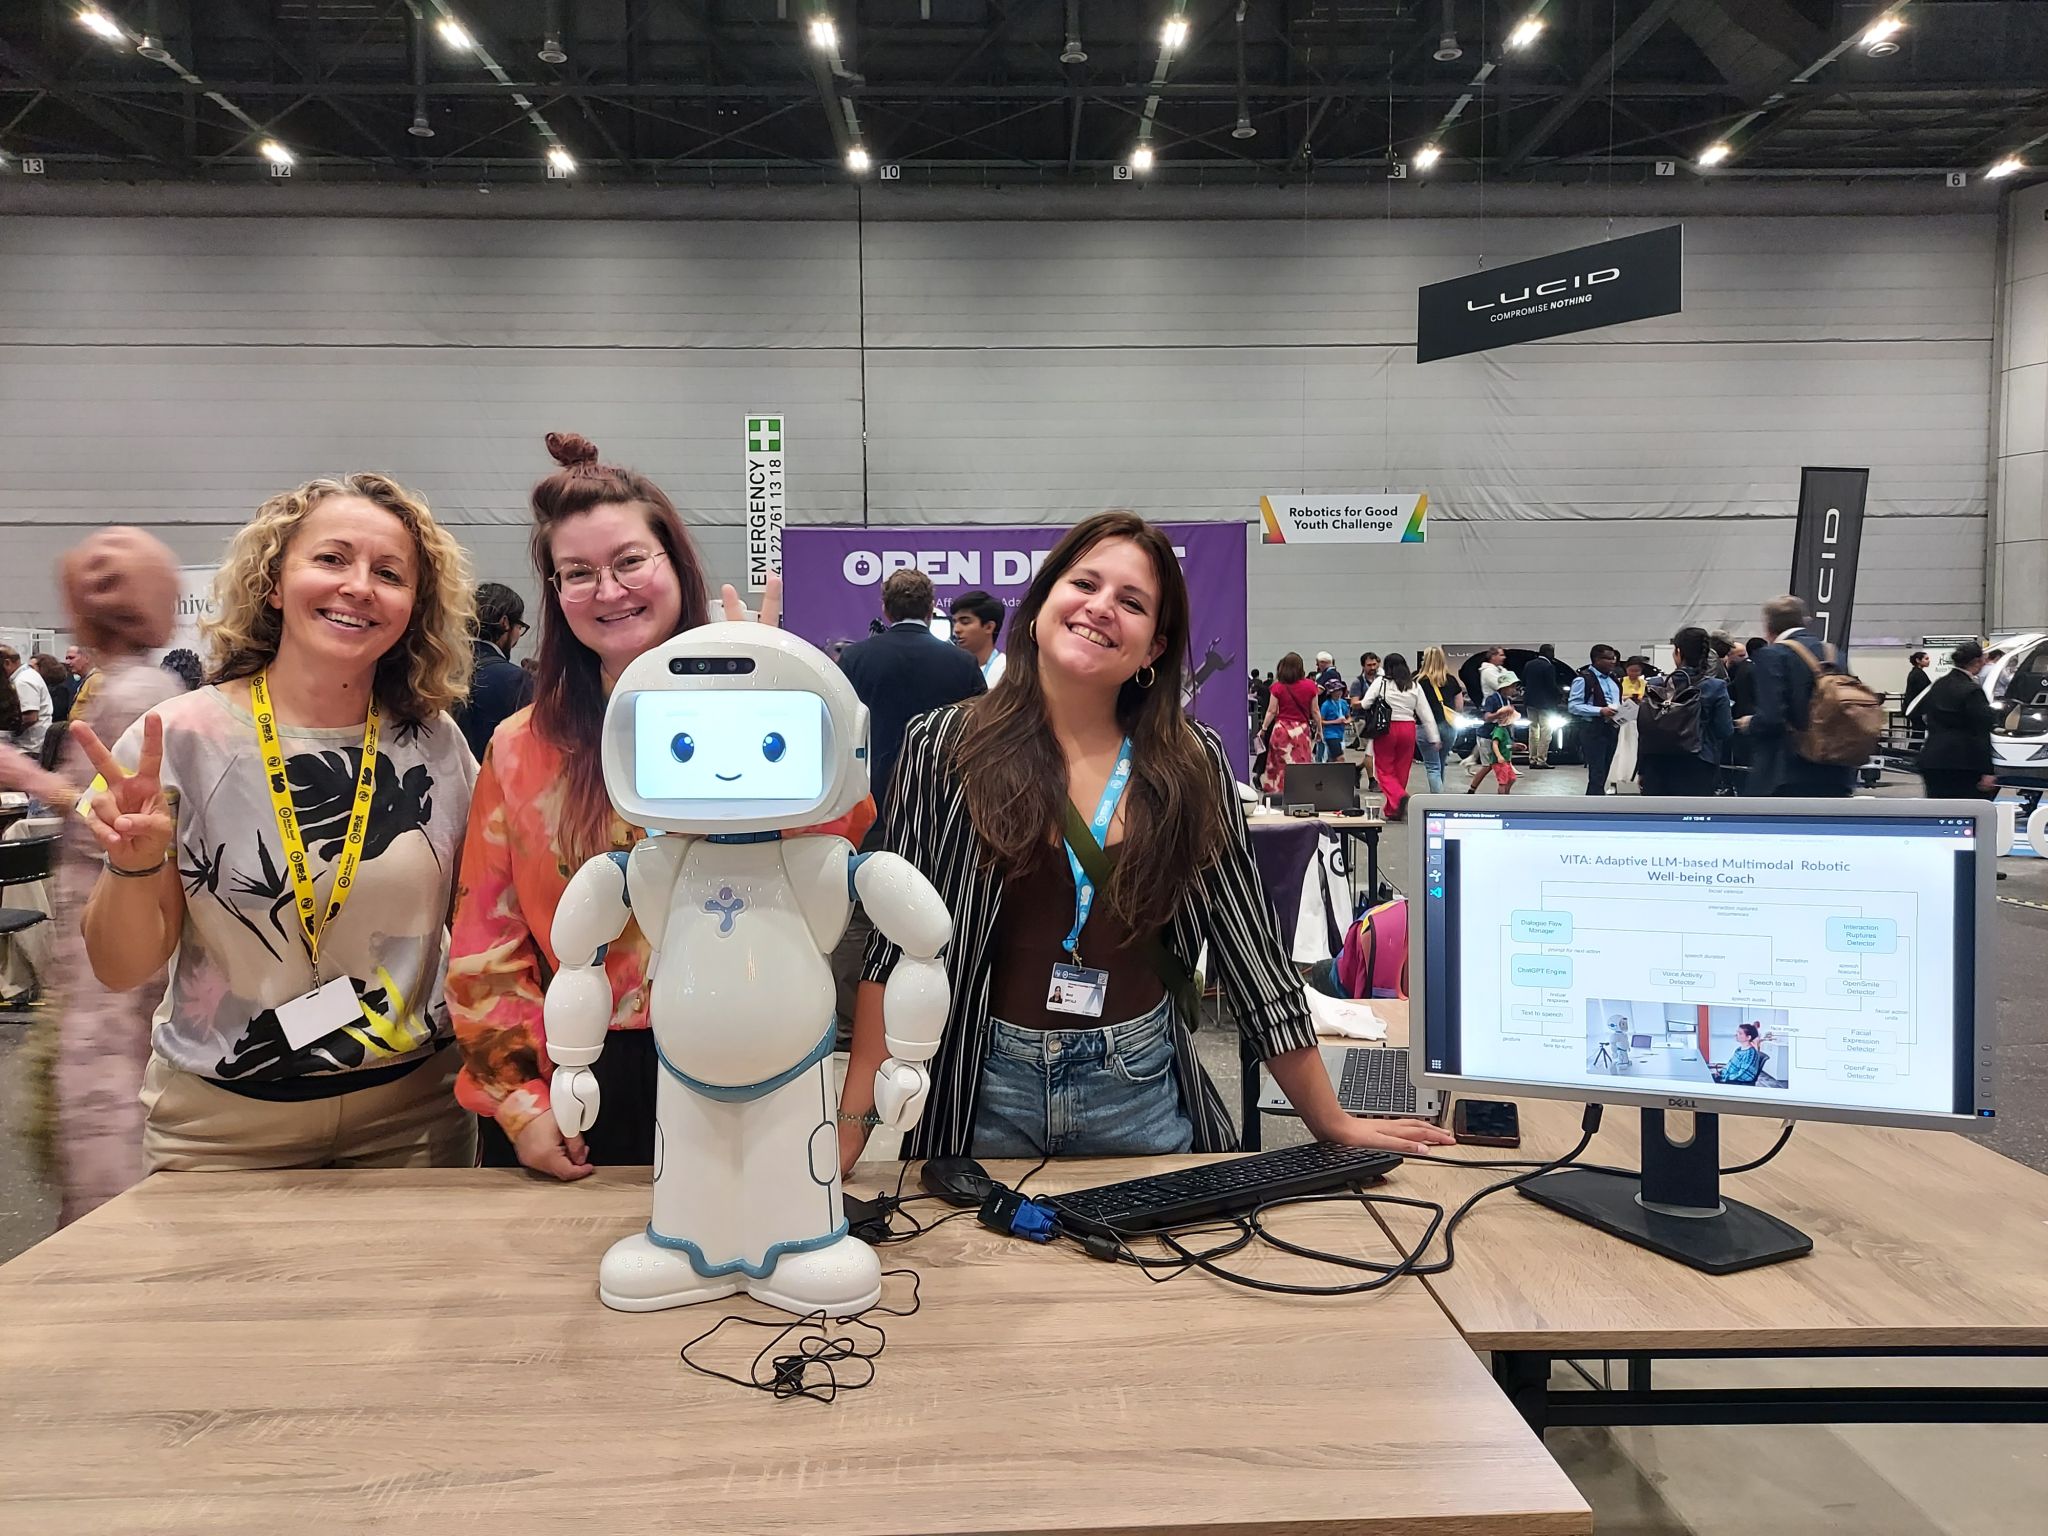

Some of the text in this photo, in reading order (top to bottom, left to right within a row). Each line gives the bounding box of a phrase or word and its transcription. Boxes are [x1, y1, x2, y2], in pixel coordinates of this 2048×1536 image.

[24, 159, 42, 173] 13
[272, 164, 289, 176] 12
[1661, 162, 1669, 175] 7
[881, 165, 899, 178] 10
[1118, 166, 1127, 179] 9
[1951, 173, 1960, 186] 6
[1467, 267, 1620, 312] LUCID
[1490, 294, 1593, 323] COMPROMISE NOTHING
[1289, 506, 1398, 517] Robotics for Good
[750, 459, 767, 586] EMERGENCY
[769, 459, 782, 577] 41 22 761 13 18
[1294, 519, 1393, 532] Youth Challenge
[843, 550, 981, 586] OPEN
[1816, 508, 1840, 643] UCID
[172, 593, 215, 615] hive
[1560, 854, 1851, 872] VITA: Adaptive LLM-based Multimodal Robotic
[1647, 871, 1755, 884] Well-being Coach
[1521, 920, 1547, 928] Dialogue
[1843, 923, 1879, 931] Interaction
[1528, 927, 1555, 935] Manager
[1845, 931, 1877, 940] Ruptures
[1846, 939, 1876, 947] Detector
[1517, 966, 1567, 976] ChatGPT Engine
[1662, 970, 1703, 980] Voice Activity
[1669, 978, 1695, 986] Detector
[1749, 978, 1774, 988] Speech
[1842, 980, 1880, 988] OpenSmile
[1846, 988, 1876, 996] Detector
[1541, 1011, 1564, 1019] speech
[1842, 1036, 1880, 1045] Expression
[1846, 1045, 1876, 1053] Detector
[1843, 1064, 1879, 1072] OpenFace
[1846, 1072, 1876, 1080] Detector
[1668, 1098, 1698, 1108] DELL
